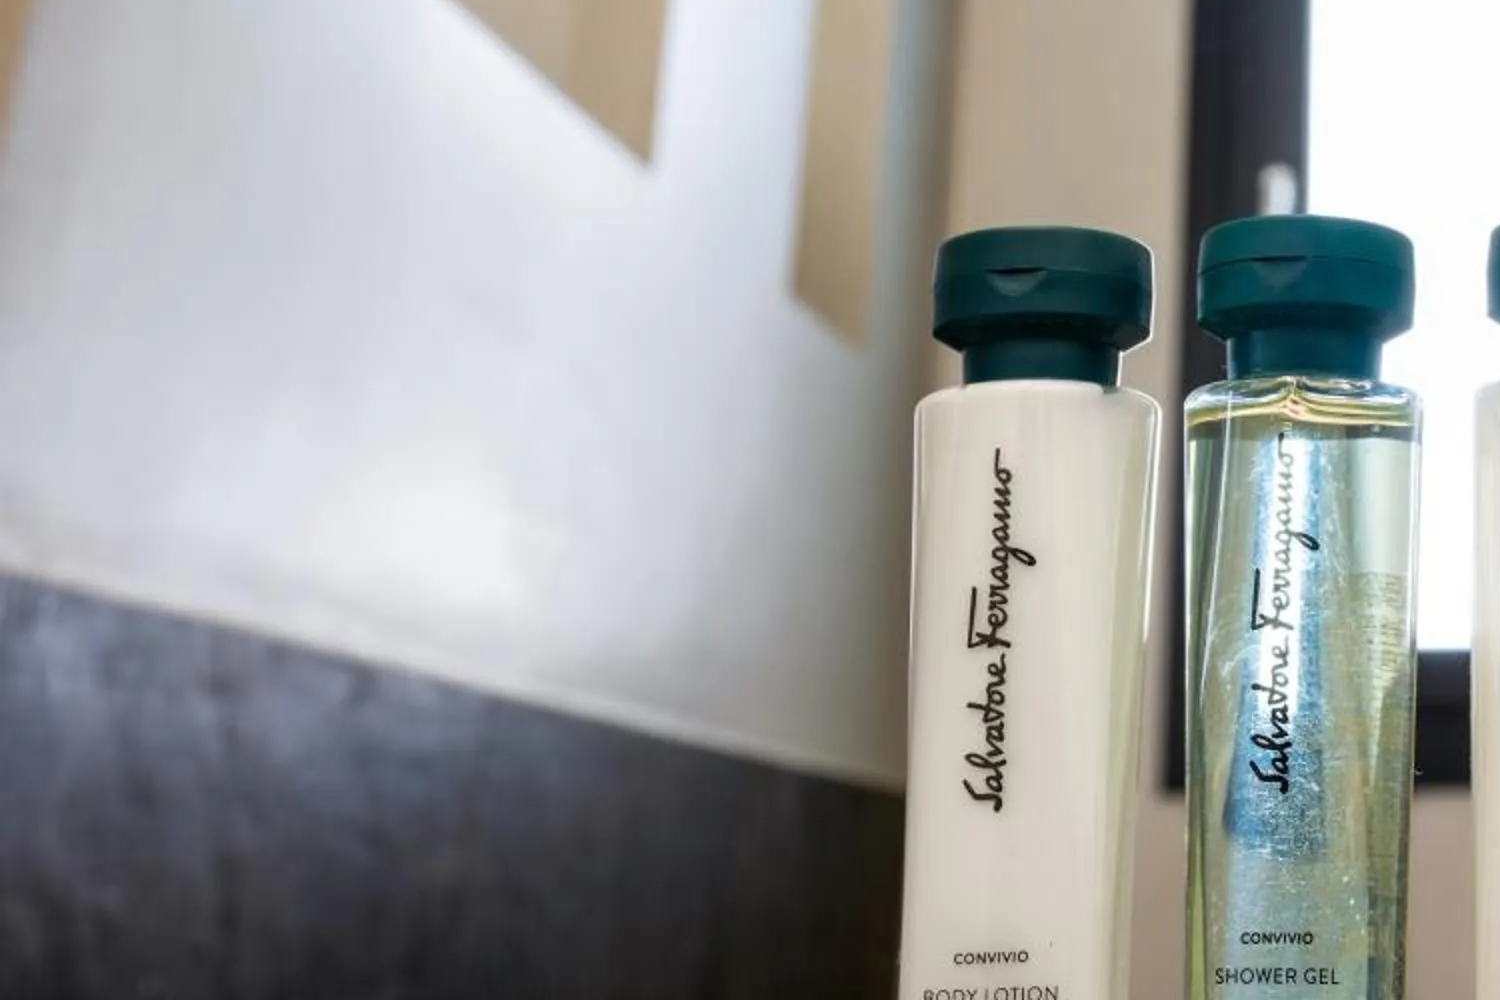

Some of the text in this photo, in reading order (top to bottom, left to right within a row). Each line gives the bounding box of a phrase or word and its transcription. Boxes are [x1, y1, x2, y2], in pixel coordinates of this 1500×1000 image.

[1249, 433, 1320, 794] Salvatore Ferragamo
[963, 447, 1036, 813] Salvatore Ferragamo
[1240, 931, 1314, 945] CONVIVIO
[953, 950, 1029, 965] CONVIVIO
[1215, 967, 1340, 985] SHOWER GEL
